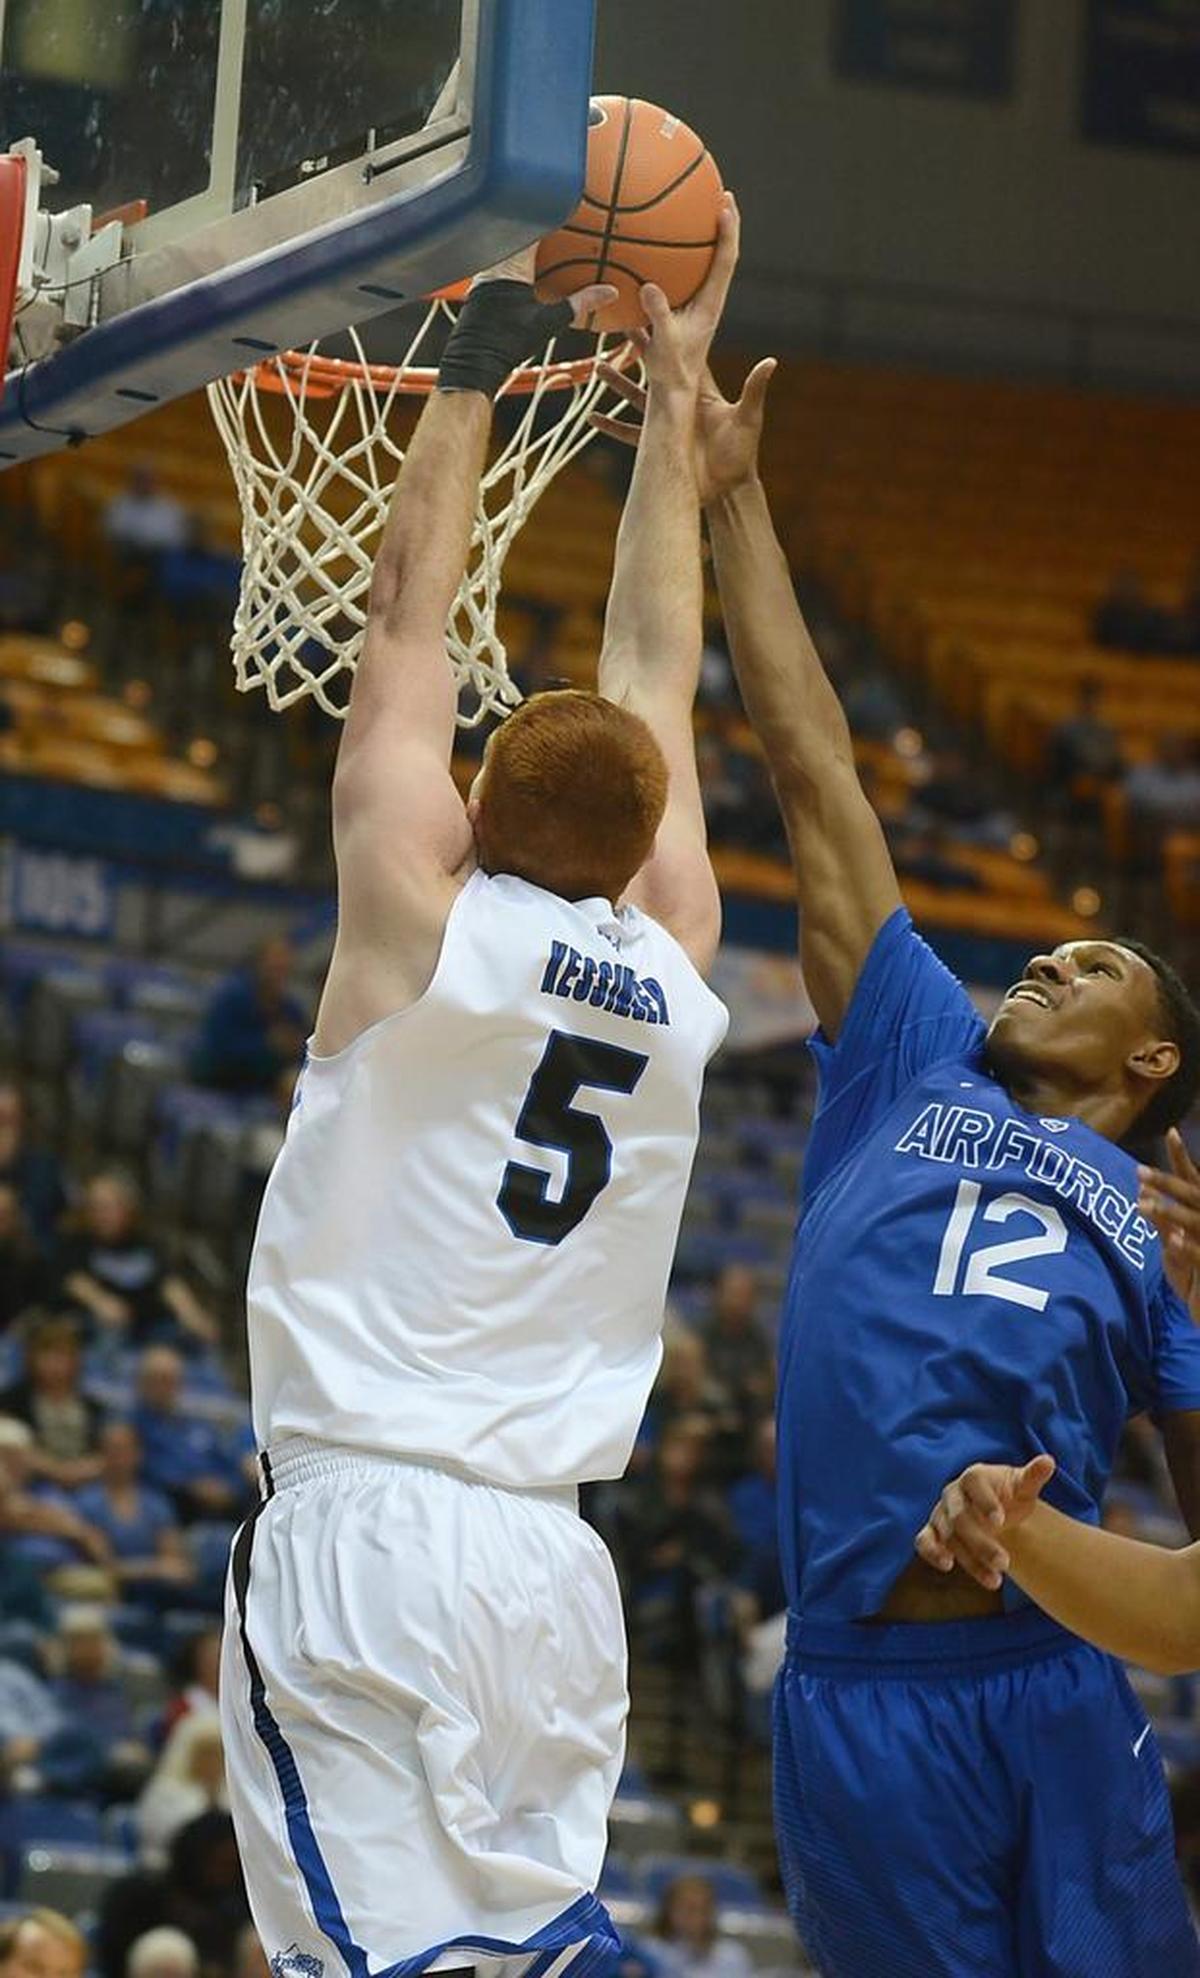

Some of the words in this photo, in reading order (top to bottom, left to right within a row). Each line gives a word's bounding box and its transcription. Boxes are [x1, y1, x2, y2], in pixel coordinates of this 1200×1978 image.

[496, 1027, 650, 1247] 5
[895, 1103, 995, 1169] AIR
[985, 1118, 1159, 1270] FORCE
[932, 1178, 1069, 1312] 12
